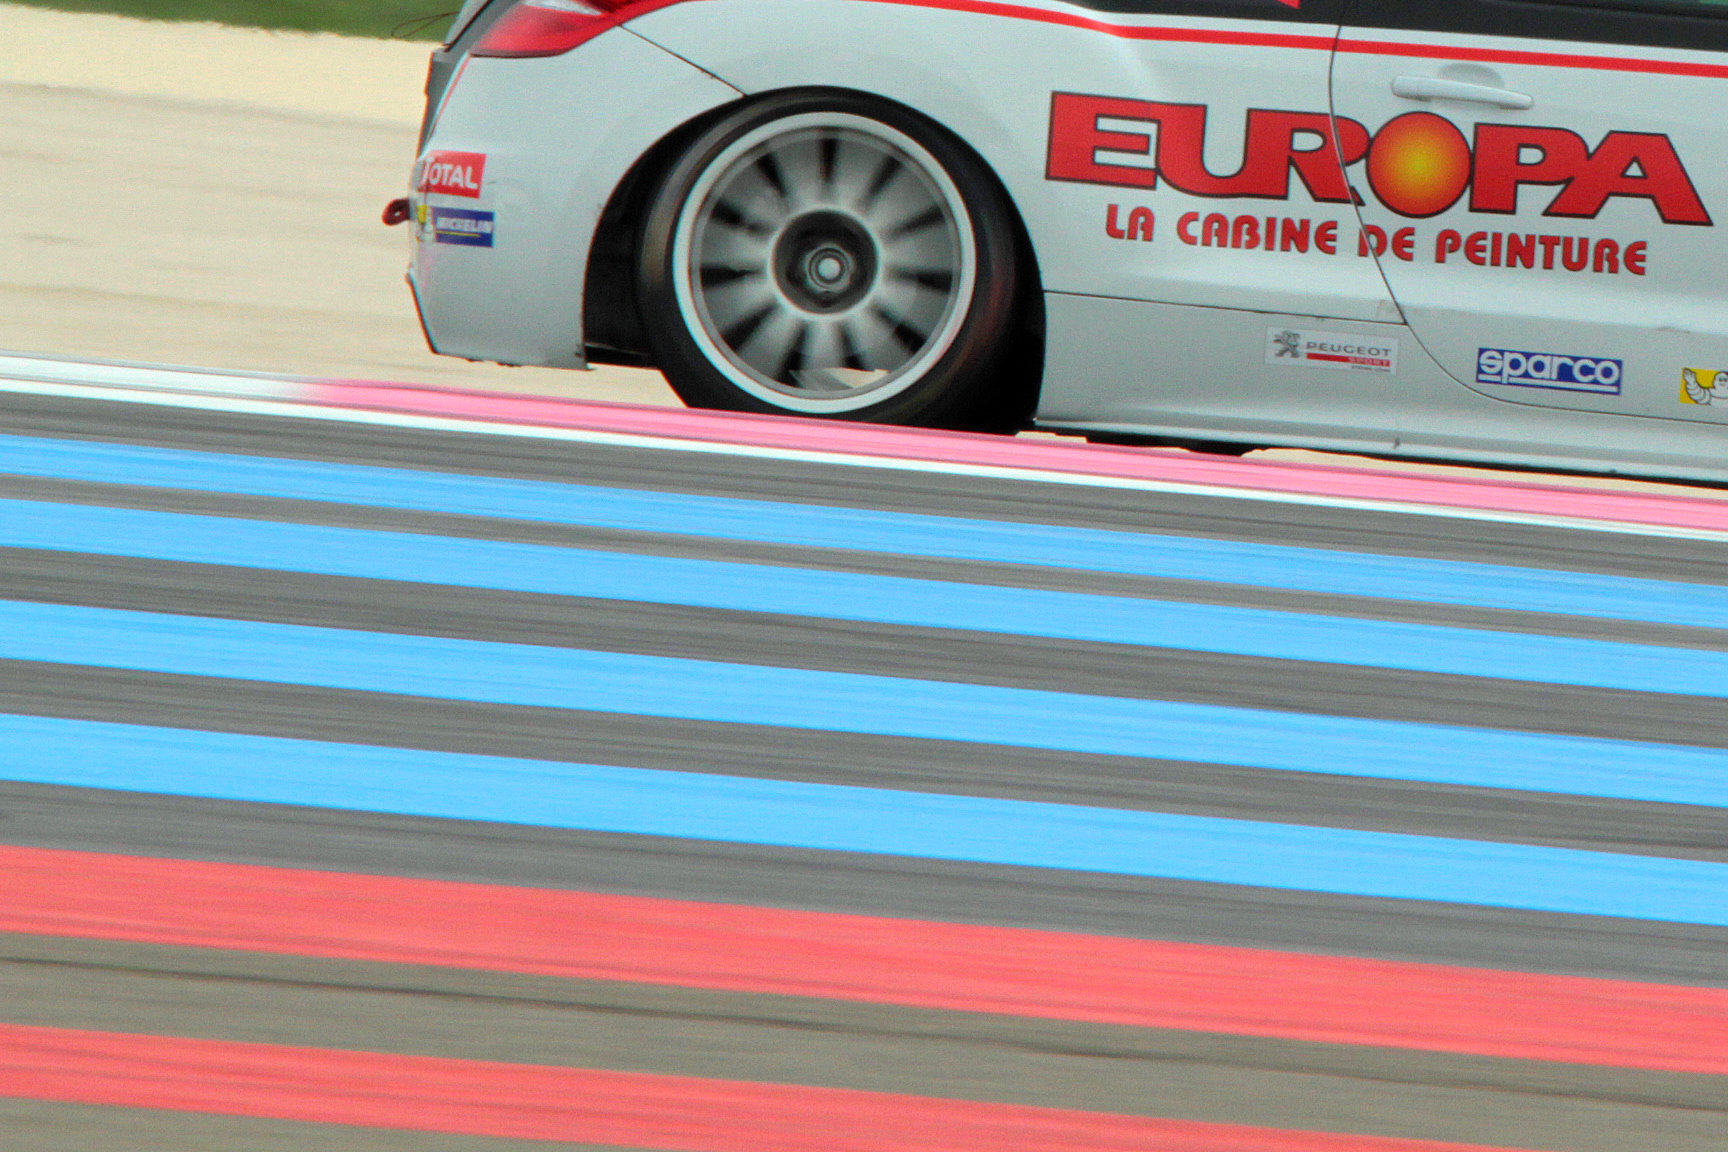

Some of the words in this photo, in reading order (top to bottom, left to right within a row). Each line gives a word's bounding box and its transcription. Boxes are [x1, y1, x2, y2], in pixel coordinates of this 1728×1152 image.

[419, 155, 479, 190] TOTAL
[1044, 89, 1714, 227] EUROPA
[1104, 202, 1155, 242] LA
[1176, 209, 1338, 256] CABINE
[1357, 224, 1414, 262] DE
[1434, 227, 1648, 277] PEINTURE
[1305, 341, 1392, 357] PEUGEOT
[1479, 348, 1620, 386] sparco
